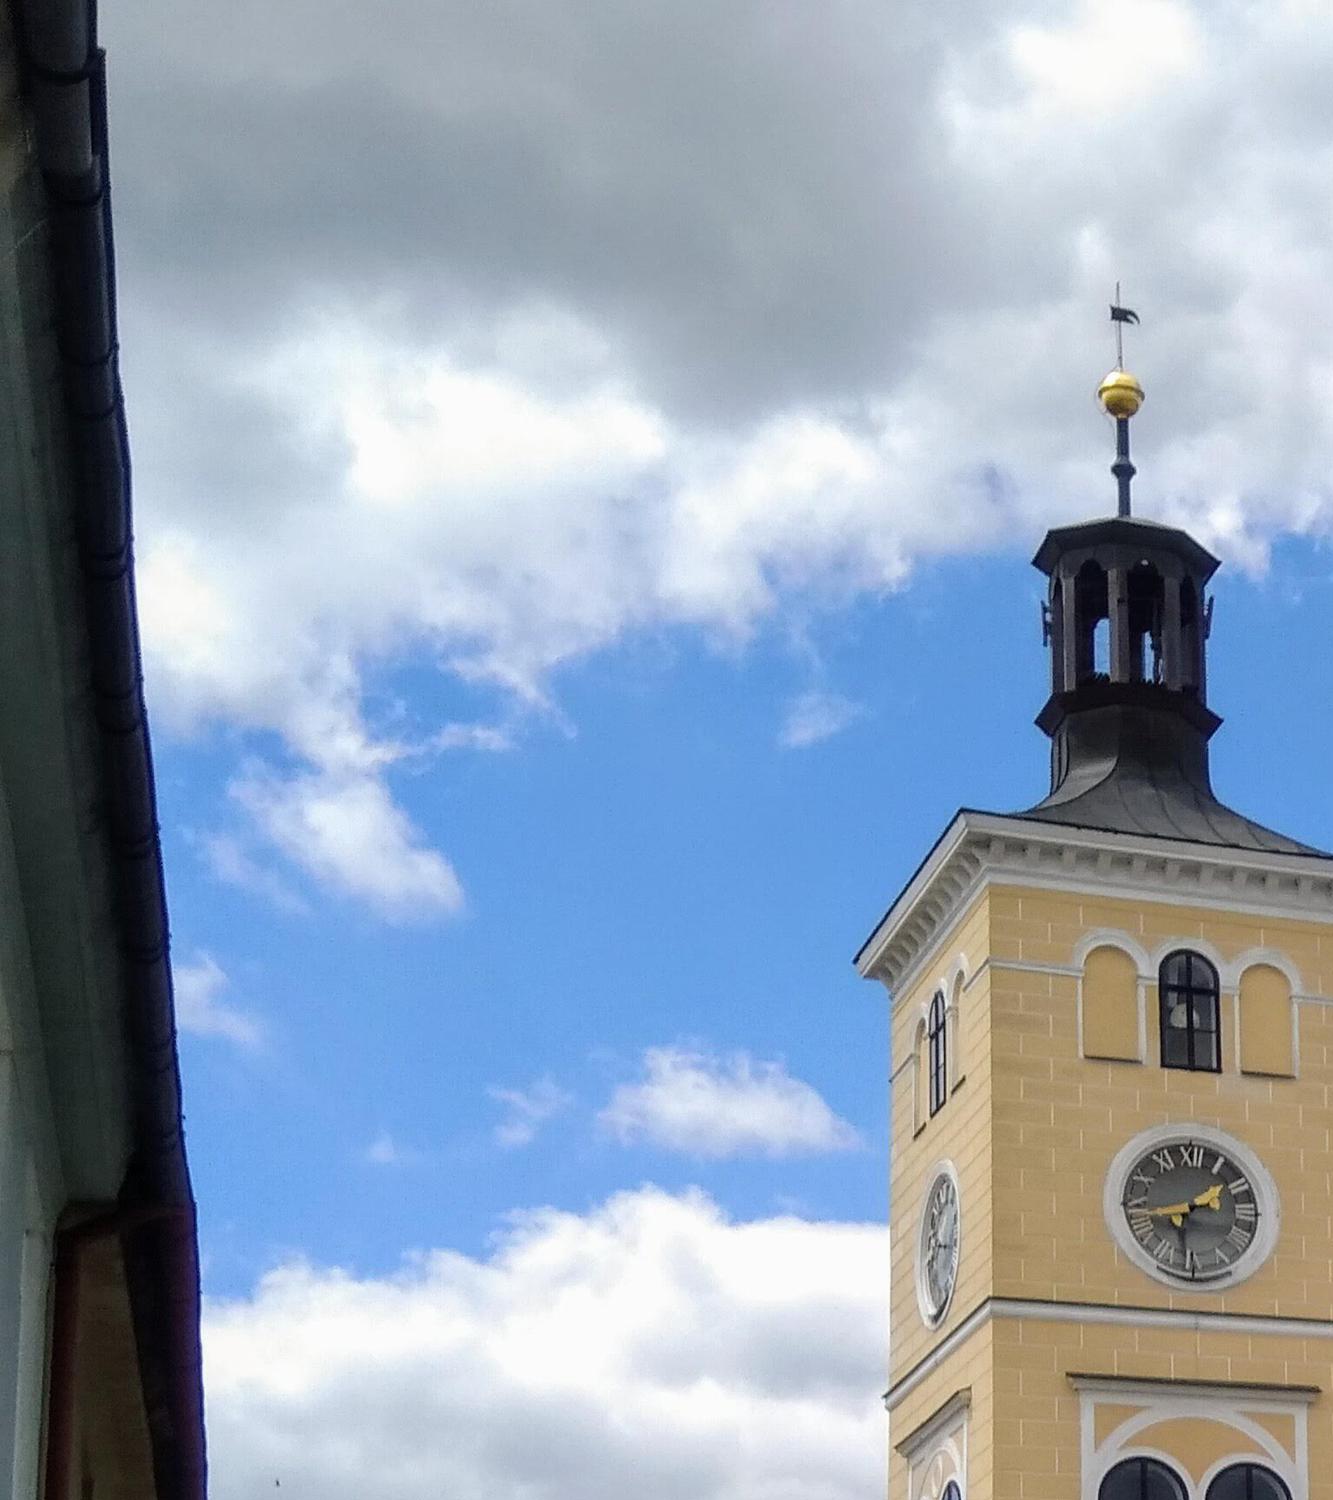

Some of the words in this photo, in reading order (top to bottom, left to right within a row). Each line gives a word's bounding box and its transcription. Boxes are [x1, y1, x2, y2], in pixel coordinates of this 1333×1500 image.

[1152, 1148, 1175, 1174] XI
[1180, 1145, 1204, 1168] XII
[1211, 1156, 1225, 1175] I
[1133, 1167, 1156, 1187] X
[1227, 1176, 1249, 1195] II
[1234, 1203, 1256, 1222] III
[1185, 1249, 1203, 1271] VI
[1215, 1247, 1231, 1265] V
